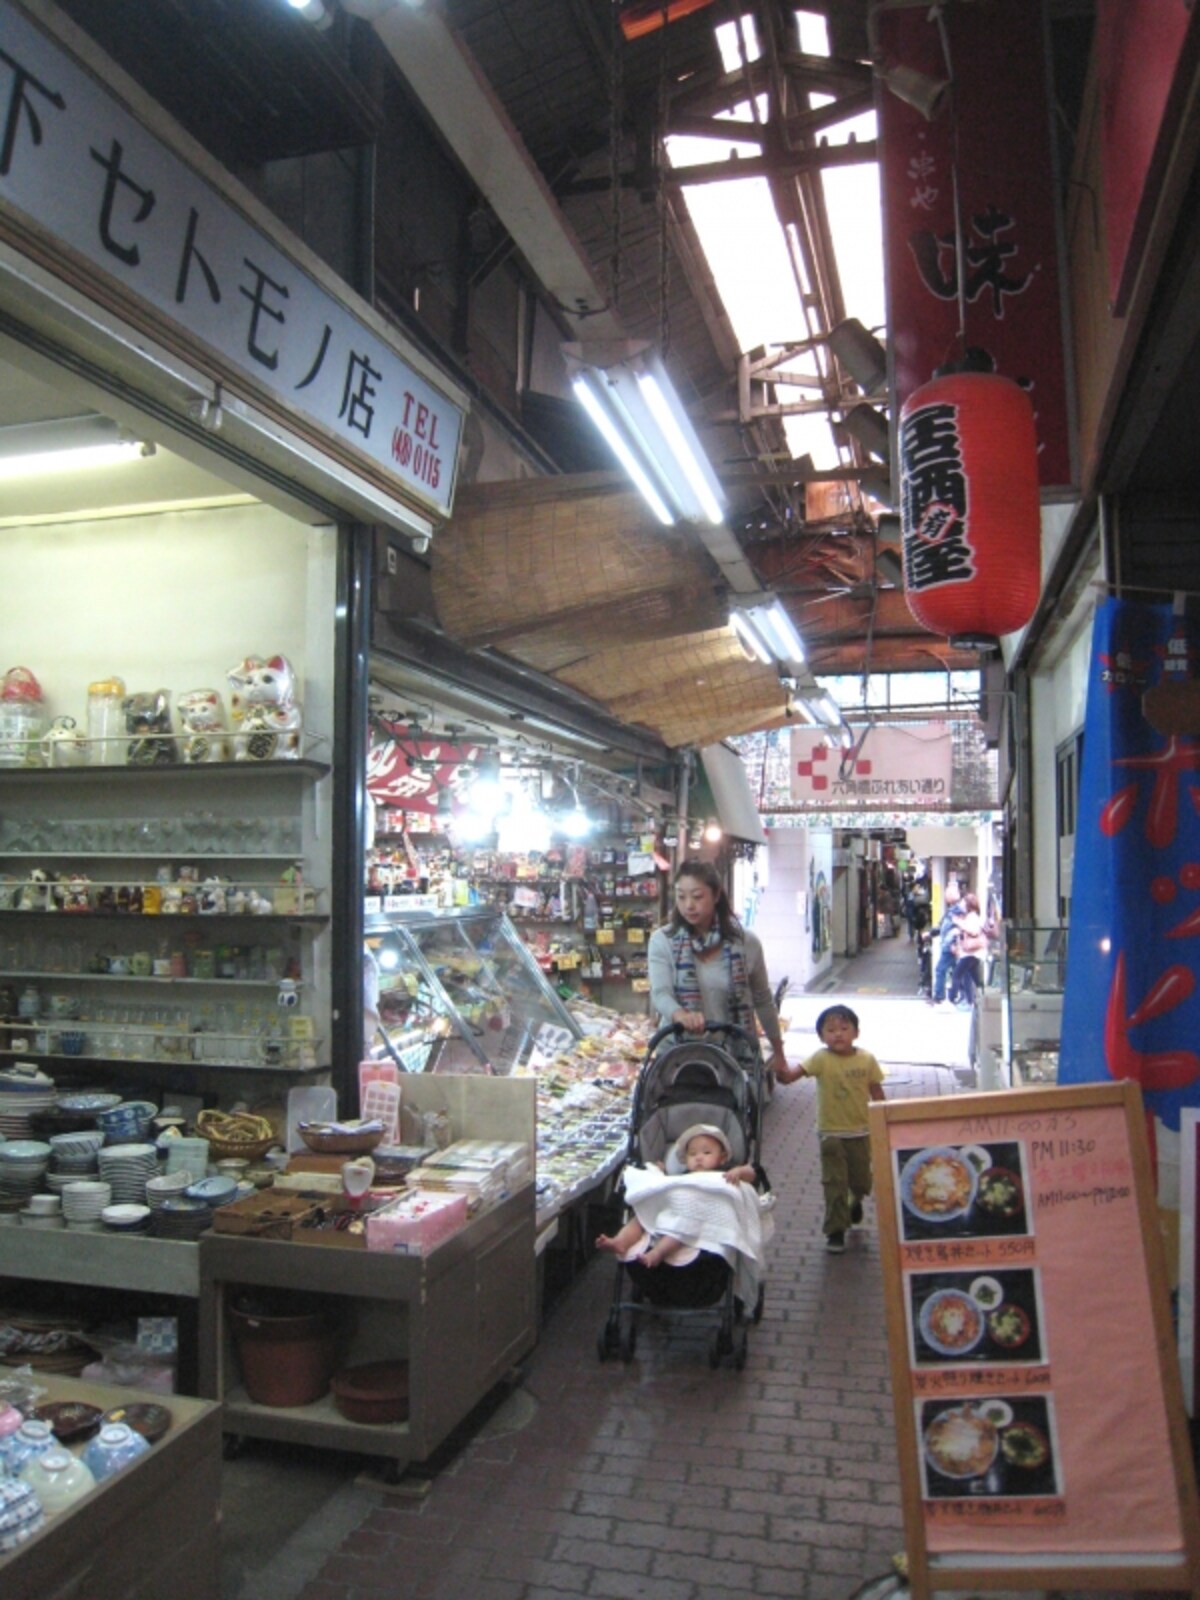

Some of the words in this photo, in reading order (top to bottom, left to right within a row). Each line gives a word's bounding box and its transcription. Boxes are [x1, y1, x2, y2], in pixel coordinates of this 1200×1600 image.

[0, 50, 382, 440] 下セトモノ店
[402, 390, 439, 451] TEL
[413, 443, 441, 490] 0115
